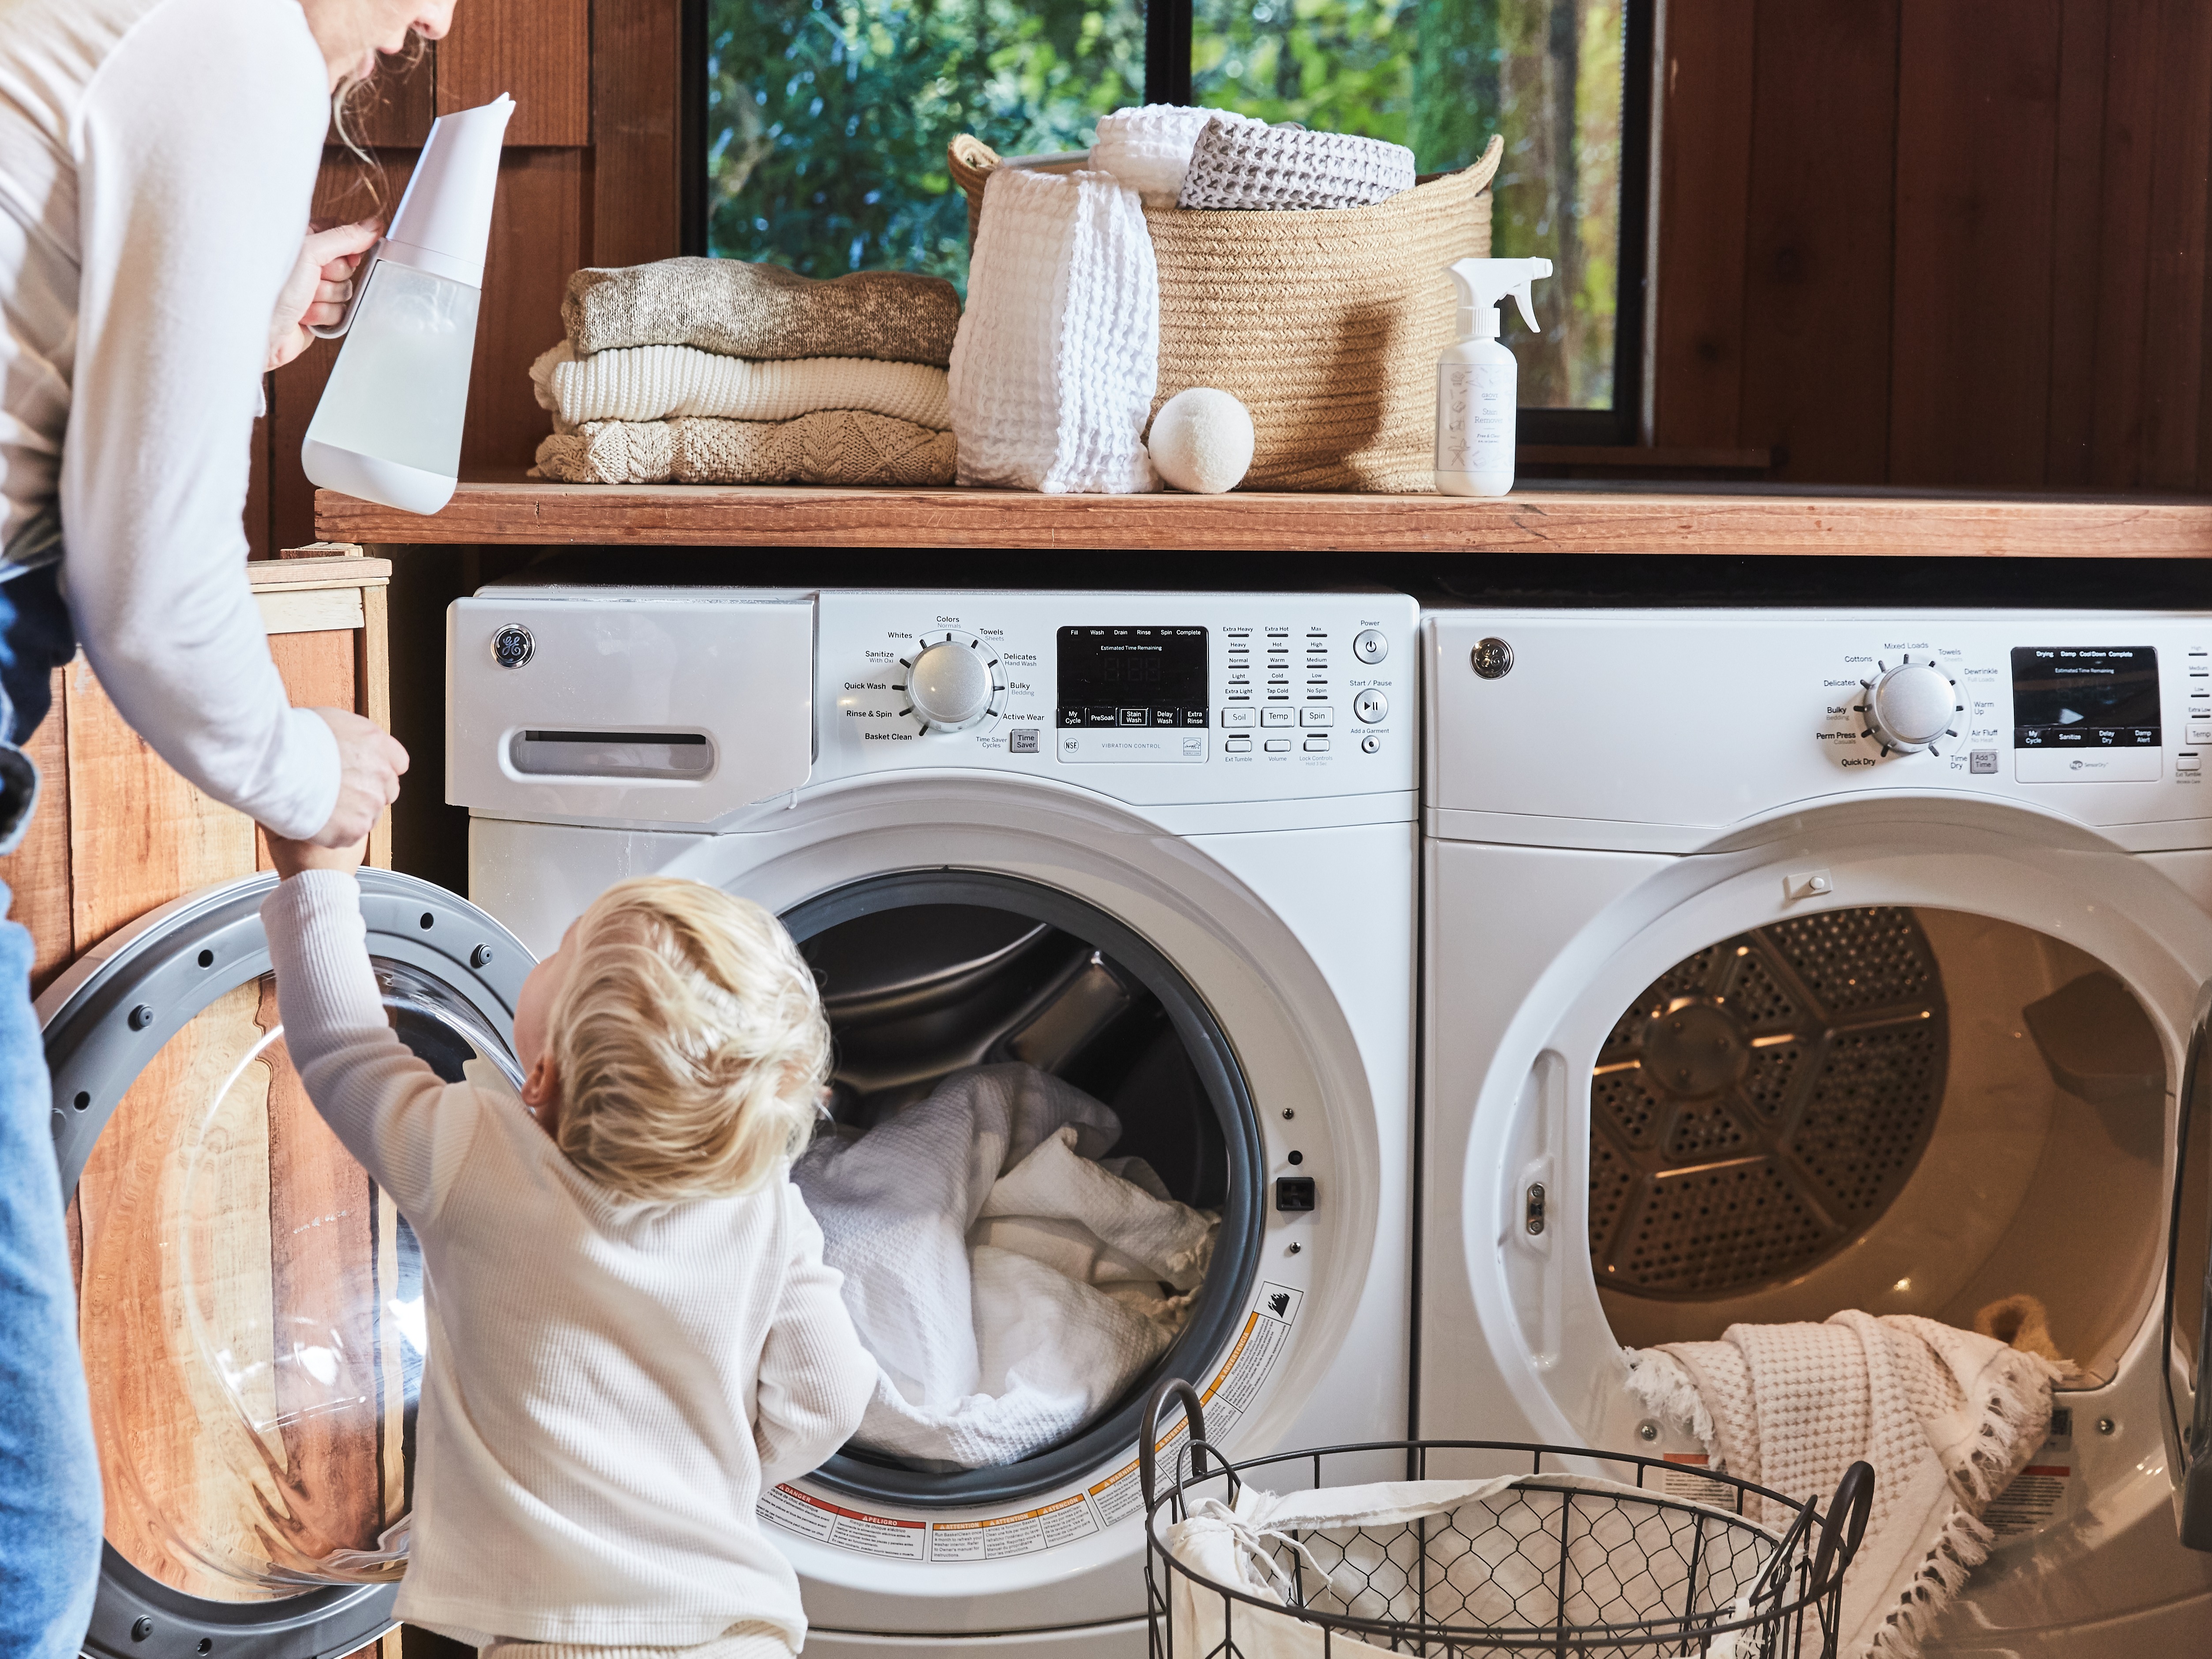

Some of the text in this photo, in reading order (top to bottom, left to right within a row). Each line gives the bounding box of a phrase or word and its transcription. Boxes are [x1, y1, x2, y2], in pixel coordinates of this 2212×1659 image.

[1109, 1463, 1137, 1483] WARNING
[785, 1488, 811, 1502] DANGER
[869, 1517, 897, 1526] PELIGRO
[996, 1513, 1028, 1524] ATTENTION
